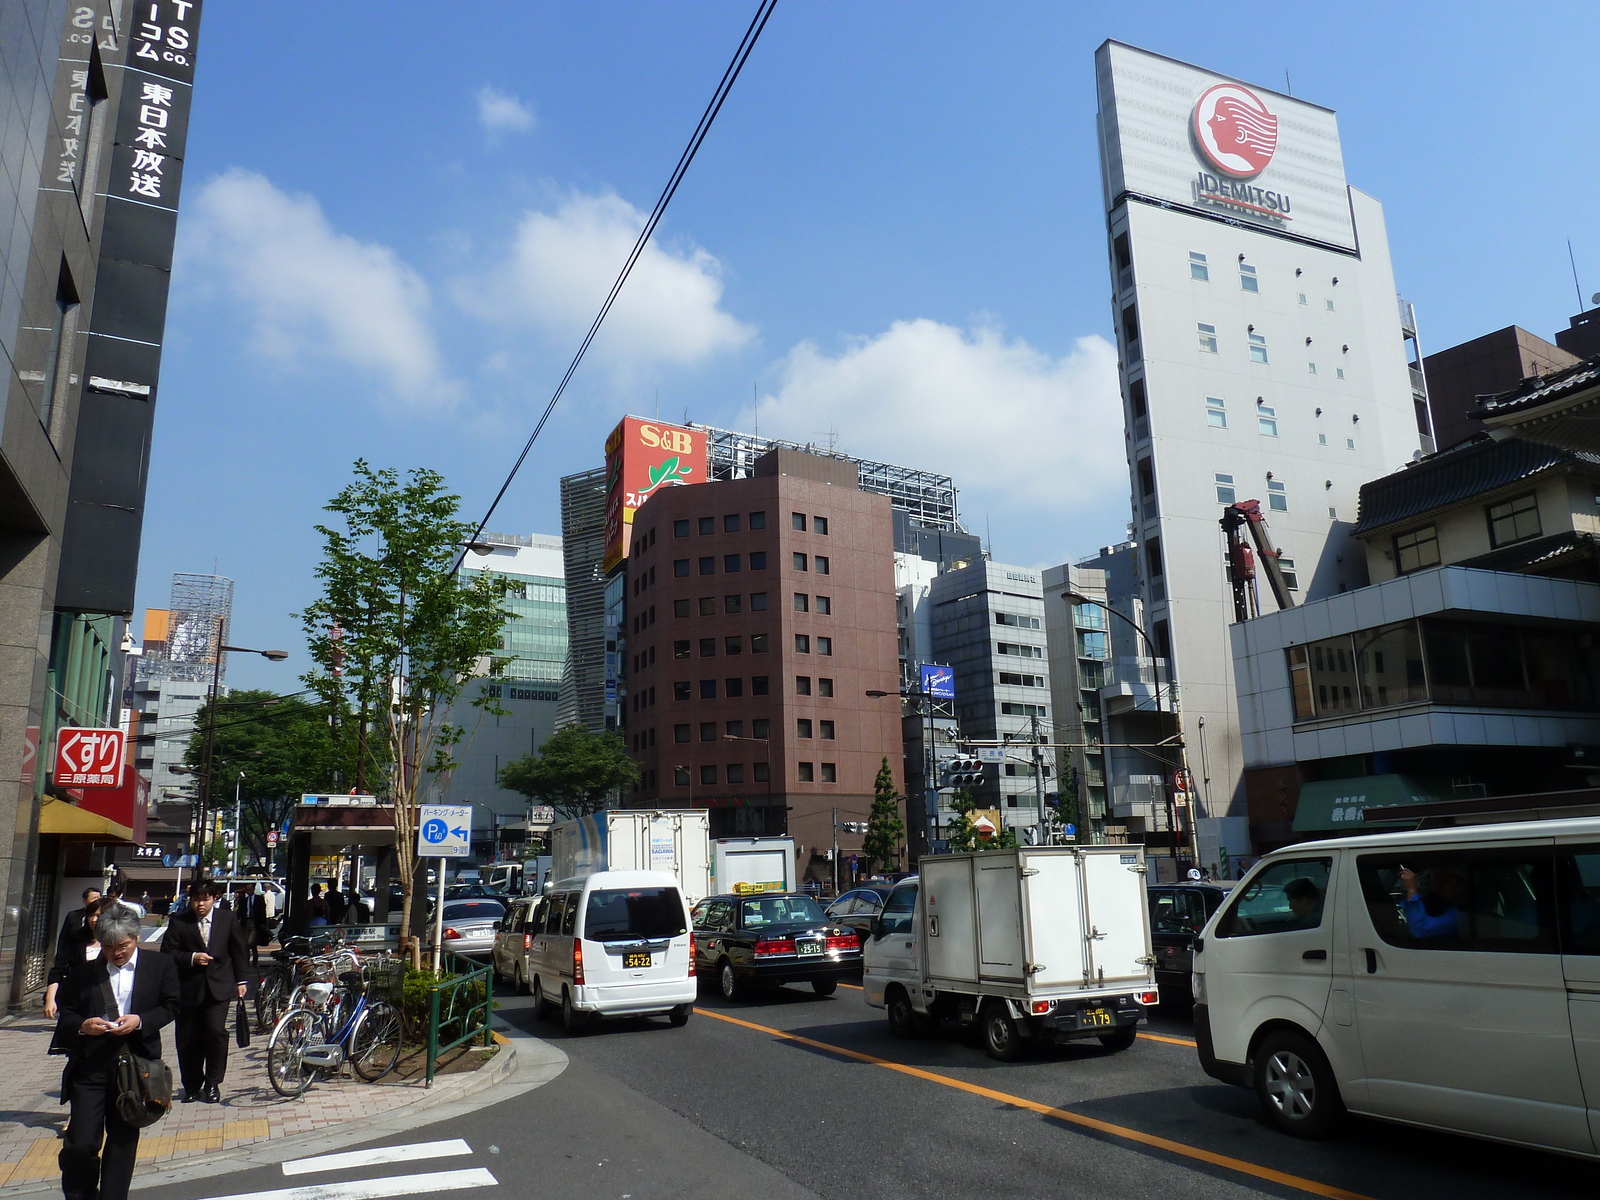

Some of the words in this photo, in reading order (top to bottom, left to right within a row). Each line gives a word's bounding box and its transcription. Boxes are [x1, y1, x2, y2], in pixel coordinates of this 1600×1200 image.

[129, 82, 174, 198] 東日本放送
[1198, 171, 1291, 214] IDEMITSU
[640, 424, 692, 455] S&B
[61, 732, 119, 773] くすり
[59, 773, 115, 785] 三原薬局
[628, 957, 651, 967] 54-22
